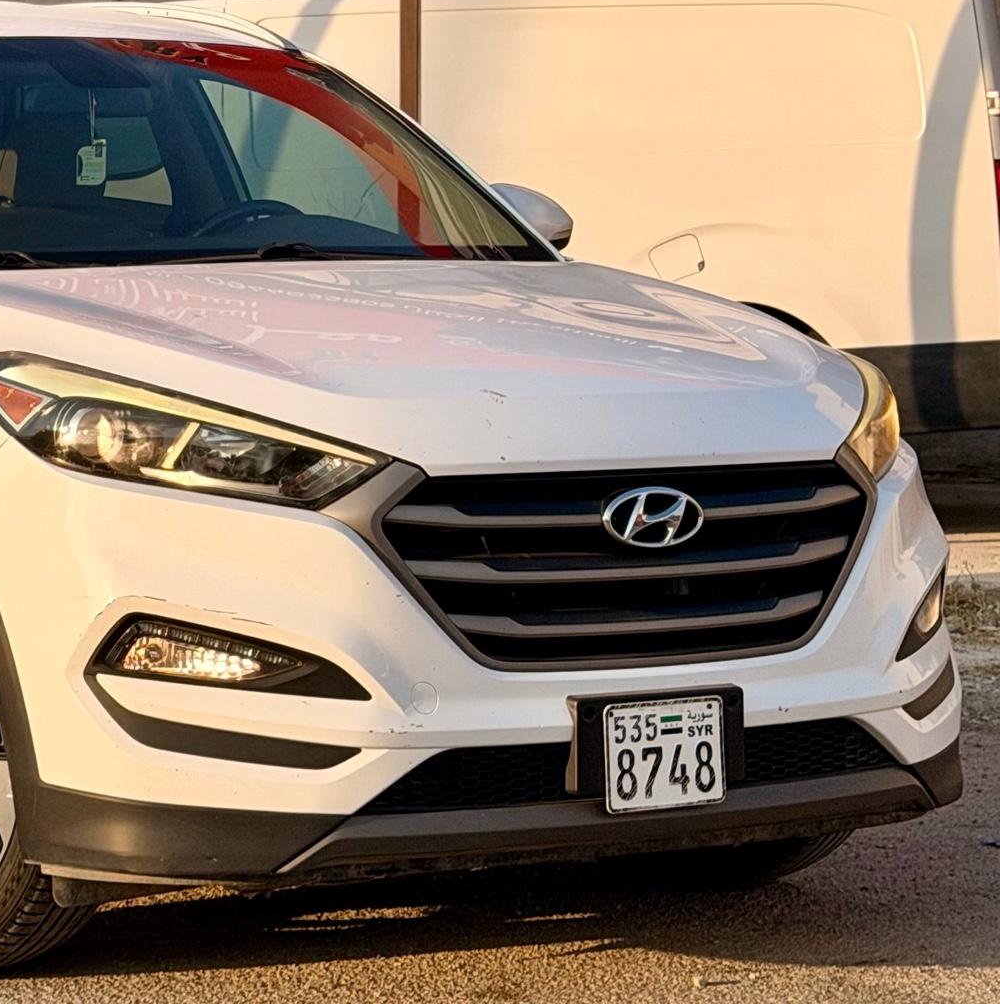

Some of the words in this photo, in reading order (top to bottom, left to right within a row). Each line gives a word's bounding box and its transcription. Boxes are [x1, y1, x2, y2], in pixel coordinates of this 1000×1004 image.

[687, 710, 714, 723] سورية
[613, 714, 658, 744] 535
[687, 724, 714, 738] SYR
[616, 741, 716, 801] 8748
